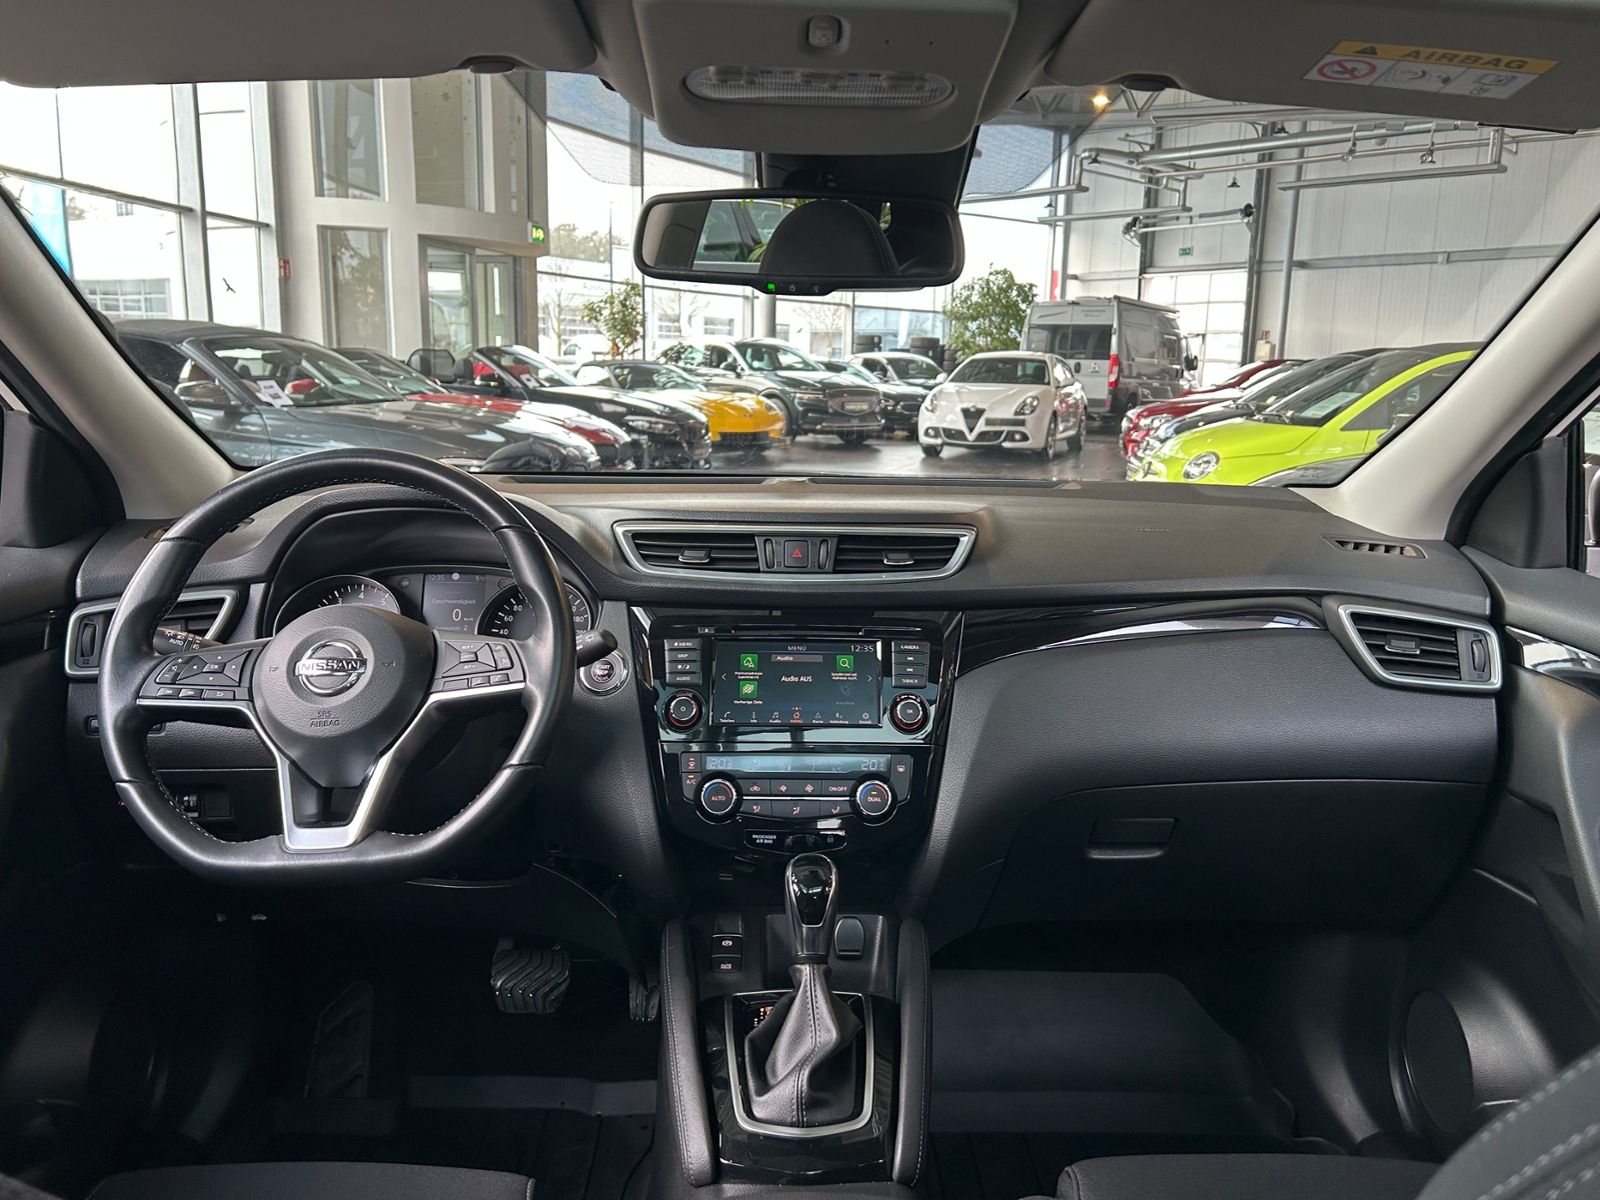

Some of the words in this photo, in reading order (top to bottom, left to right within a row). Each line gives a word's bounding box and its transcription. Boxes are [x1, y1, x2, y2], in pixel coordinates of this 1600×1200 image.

[1400, 49, 1530, 70] AIRBAG
[337, 597, 343, 605] 3
[512, 604, 524, 612] 80
[452, 608, 462, 622] 0
[573, 615, 585, 623] 180
[169, 638, 184, 646] AUTO
[850, 644, 875, 653] 12:35
[300, 659, 360, 672] NISSAN
[317, 710, 333, 719] SRS
[309, 719, 341, 729] AIRBAG
